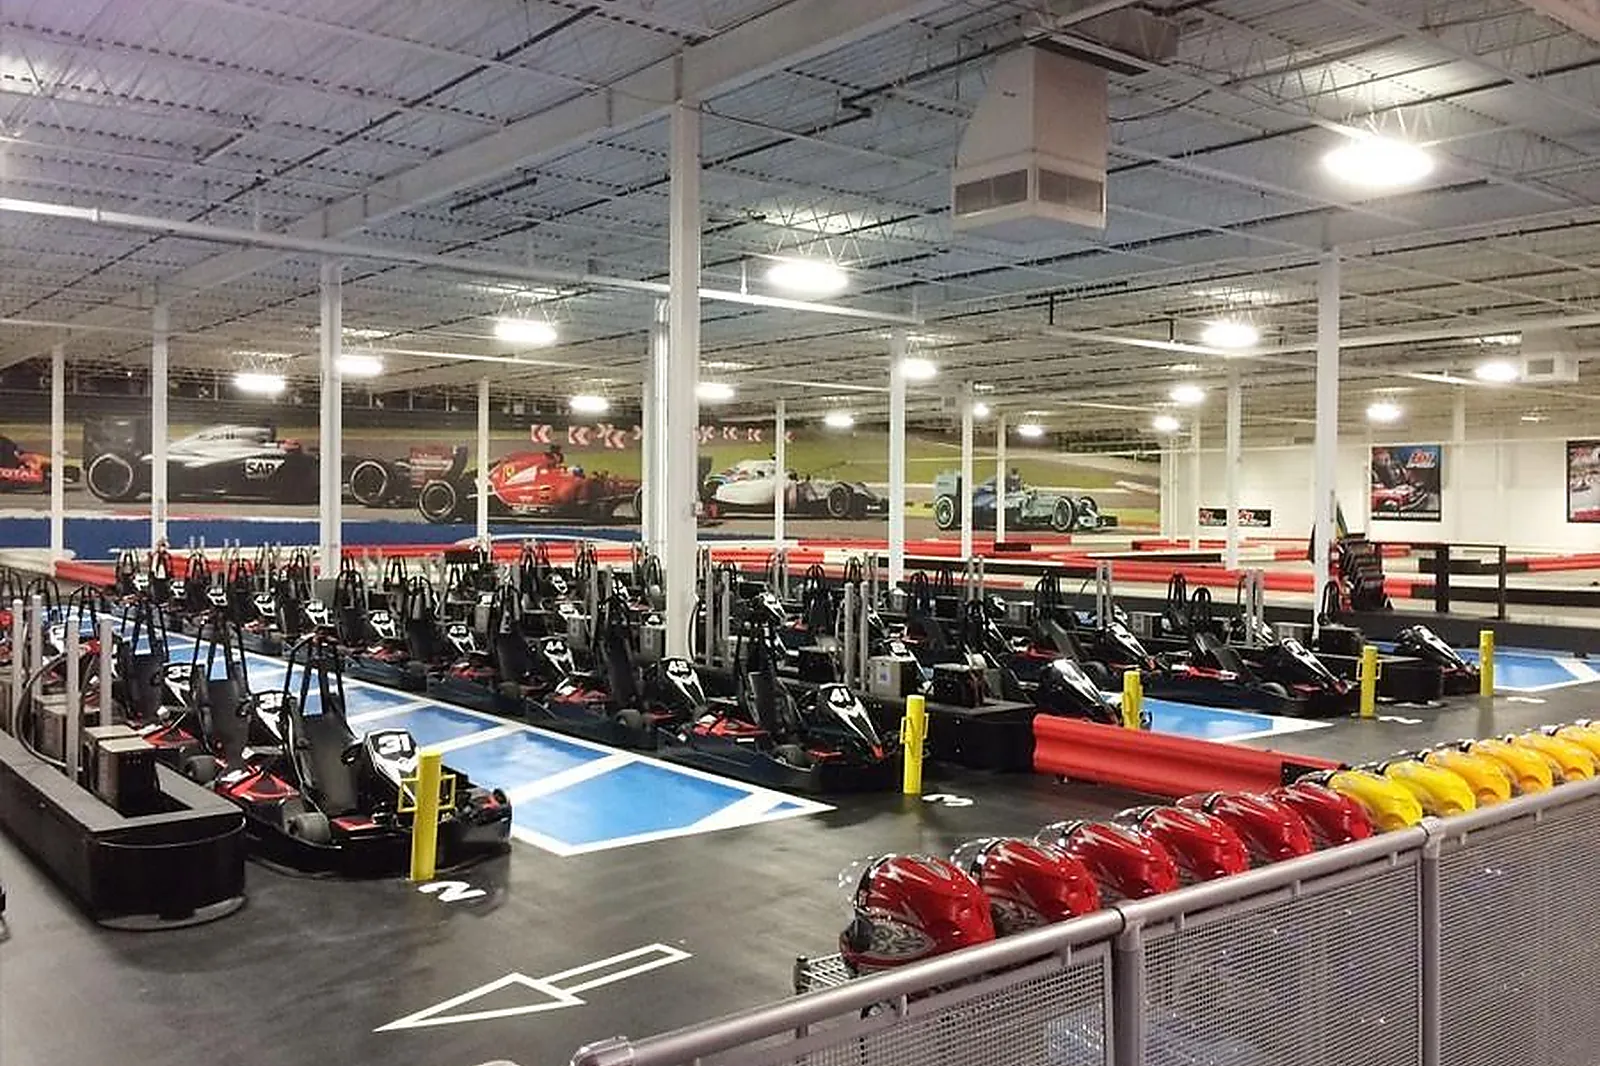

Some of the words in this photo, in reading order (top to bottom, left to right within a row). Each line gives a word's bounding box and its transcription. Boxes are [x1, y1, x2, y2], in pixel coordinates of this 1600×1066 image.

[0, 467, 42, 482] OTAL
[245, 460, 275, 477] SAP
[546, 641, 564, 651] 44
[668, 660, 689, 673] 42
[830, 688, 851, 703] 41
[377, 733, 411, 755] 31
